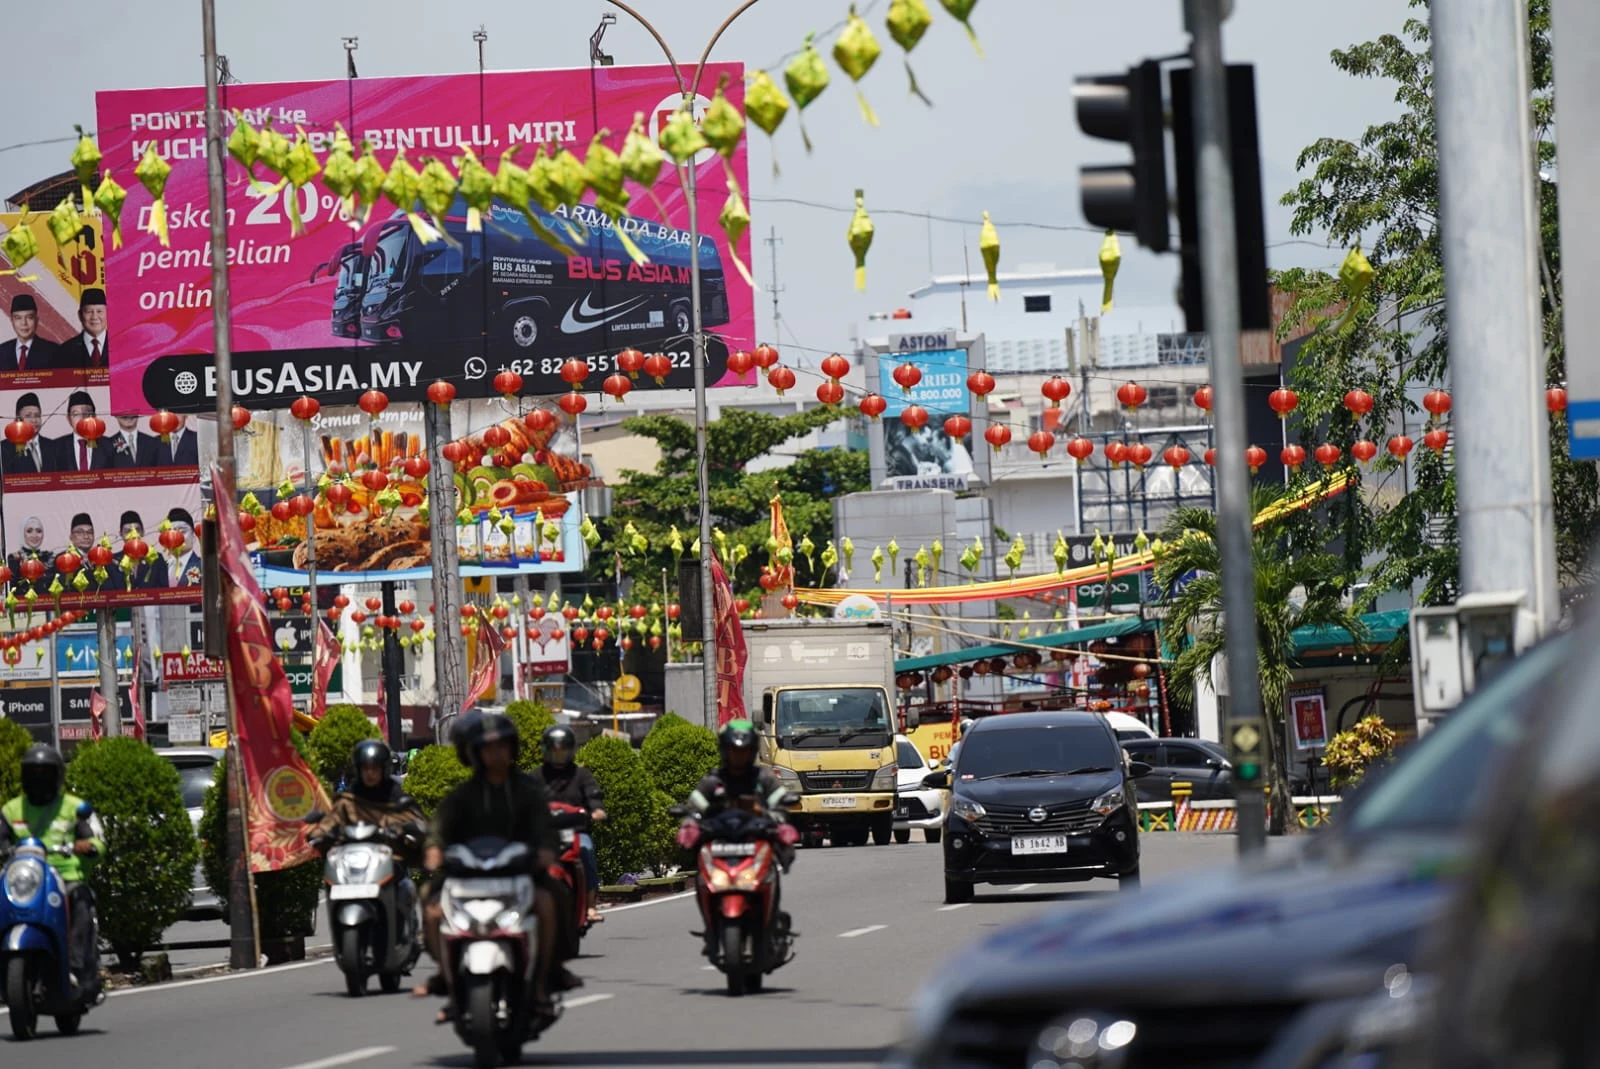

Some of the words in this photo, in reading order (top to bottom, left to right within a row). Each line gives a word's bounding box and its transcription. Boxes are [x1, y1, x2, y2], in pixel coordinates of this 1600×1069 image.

[279, 107, 307, 124] ke
[508, 120, 576, 145] MIRI
[492, 262, 513, 271] BUS
[515, 263, 536, 273] ASIA
[567, 256, 622, 280] BUS
[899, 334, 947, 349] ASTON
[310, 412, 361, 431] Semua
[897, 477, 965, 490] TRANSERA
